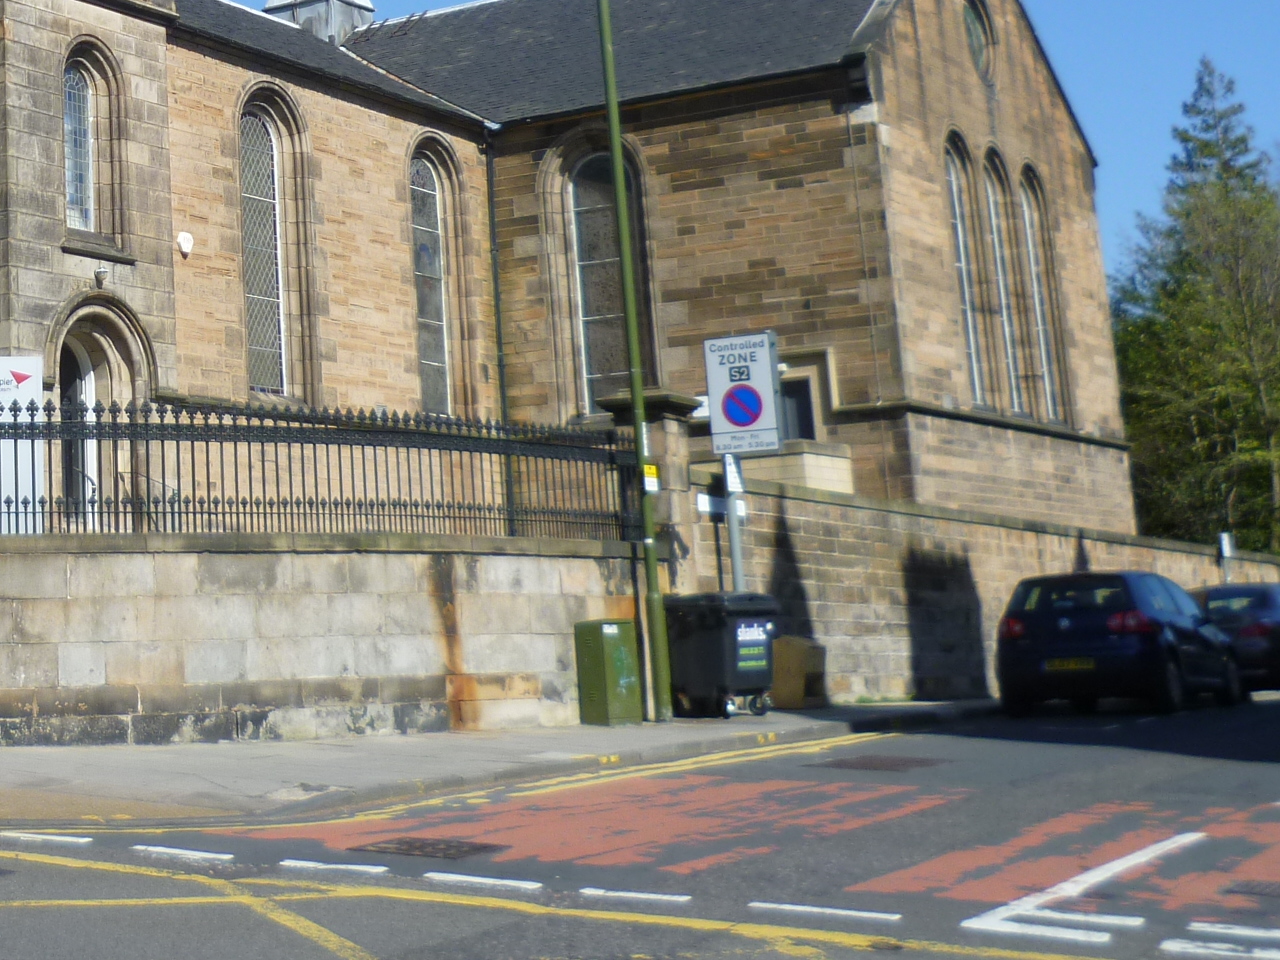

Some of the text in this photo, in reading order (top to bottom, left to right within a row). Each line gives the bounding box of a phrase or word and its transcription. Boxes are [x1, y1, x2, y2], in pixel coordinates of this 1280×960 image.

[709, 339, 764, 352] Controlled
[718, 352, 757, 365] ZONE
[731, 367, 749, 381] S2
